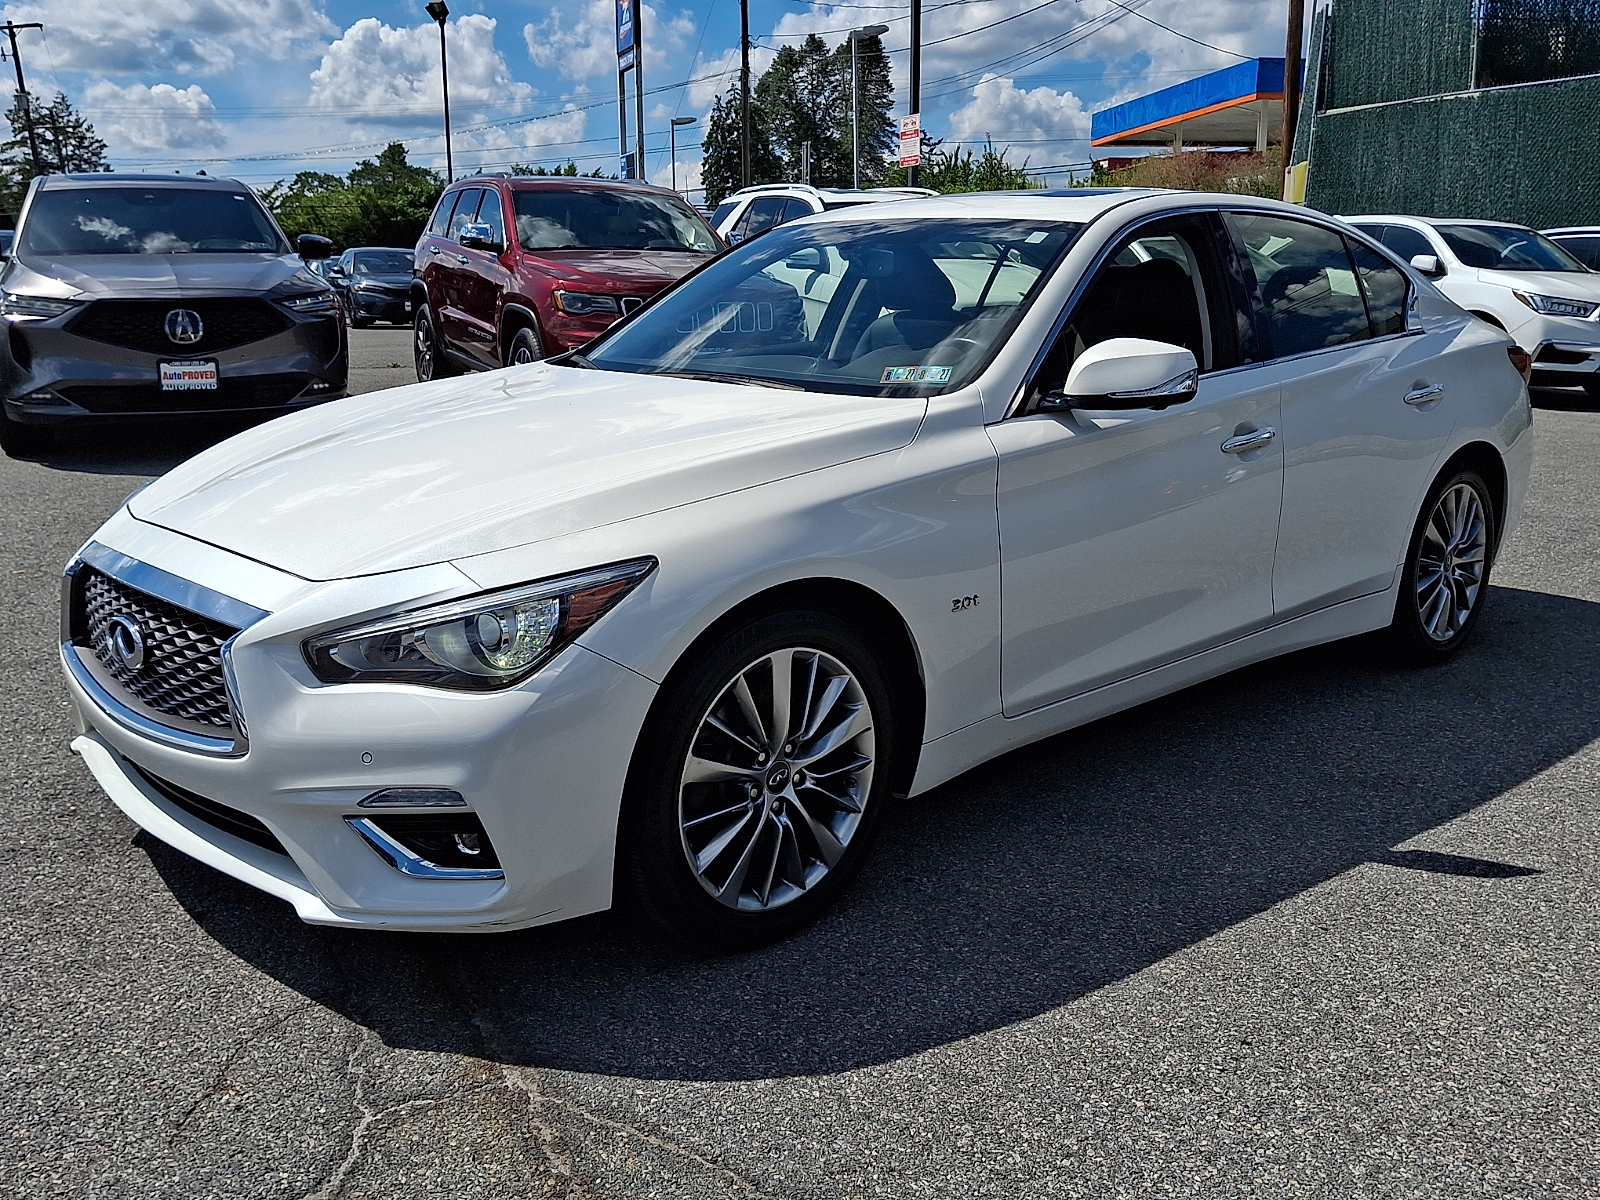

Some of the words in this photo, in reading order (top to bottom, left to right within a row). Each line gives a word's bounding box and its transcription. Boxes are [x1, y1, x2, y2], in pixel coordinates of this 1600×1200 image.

[163, 370, 216, 380] AutoPROVED
[905, 368, 916, 380] 27
[940, 368, 950, 380] 27
[162, 383, 218, 391] AUTOPROVED
